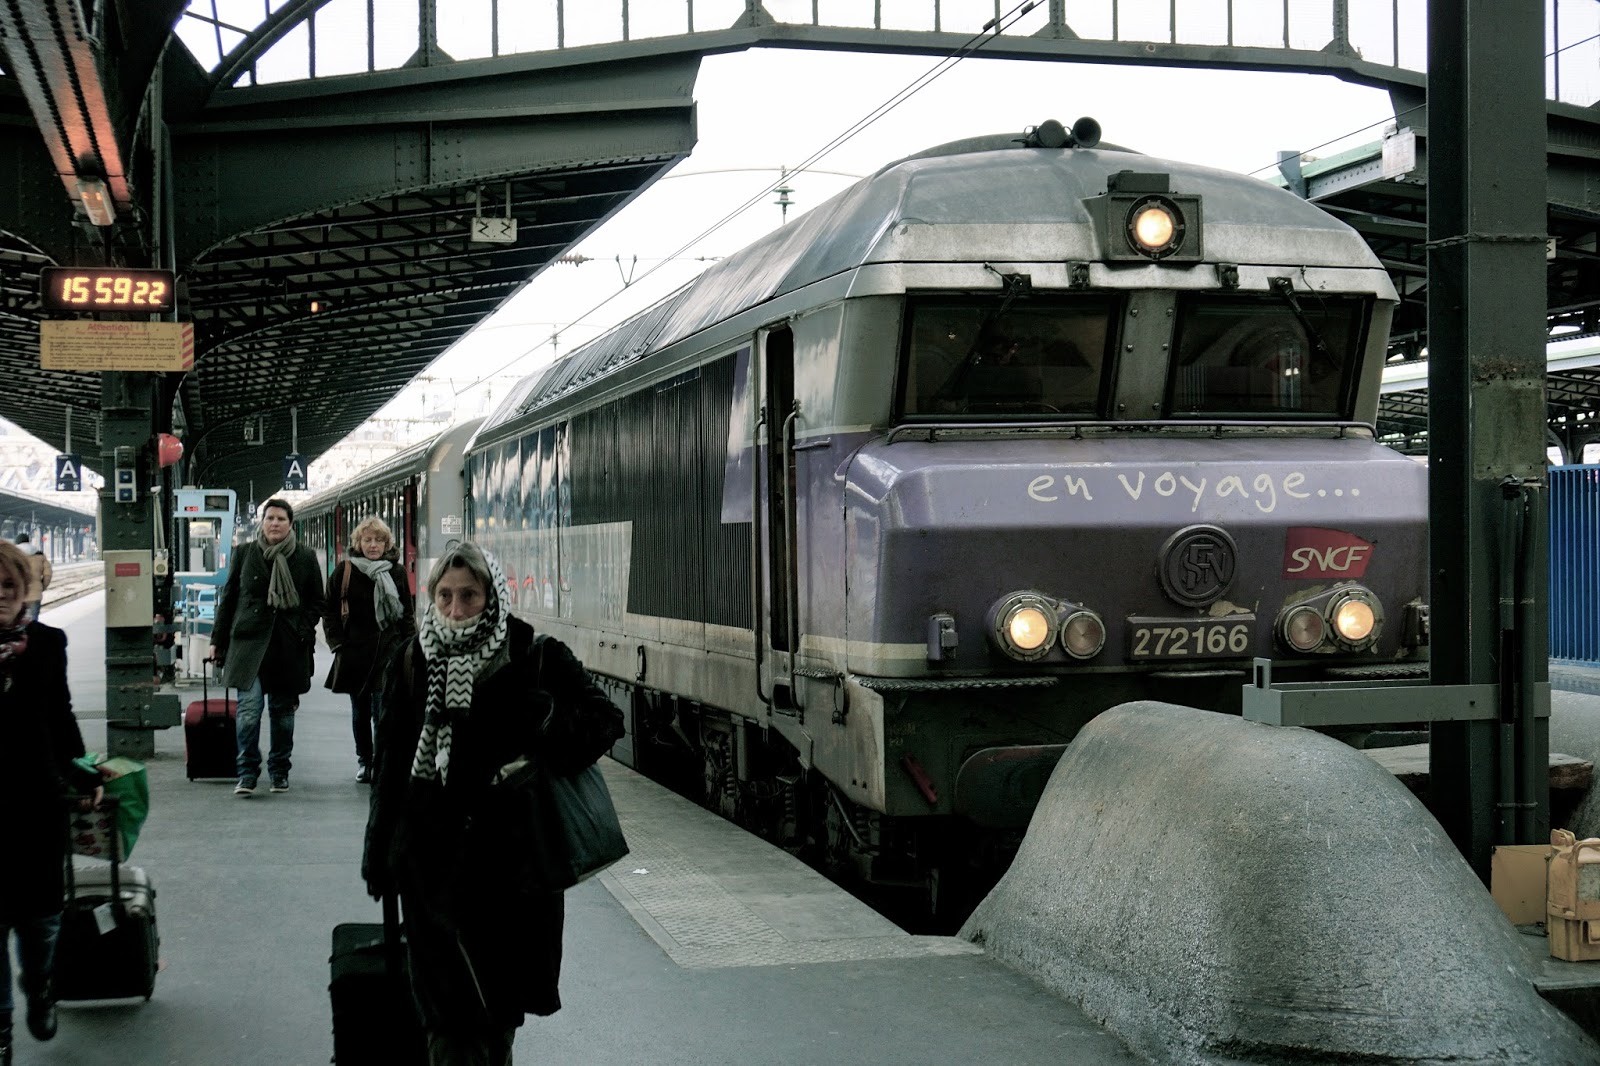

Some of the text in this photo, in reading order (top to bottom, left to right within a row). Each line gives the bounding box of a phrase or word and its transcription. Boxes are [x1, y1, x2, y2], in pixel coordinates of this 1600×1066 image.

[60, 460, 78, 479] A
[287, 460, 304, 478] A
[1027, 471, 1361, 513] en voyage...
[248, 504, 255, 514] B
[1287, 545, 1370, 573] SNCF
[1133, 624, 1249, 656] 272166
